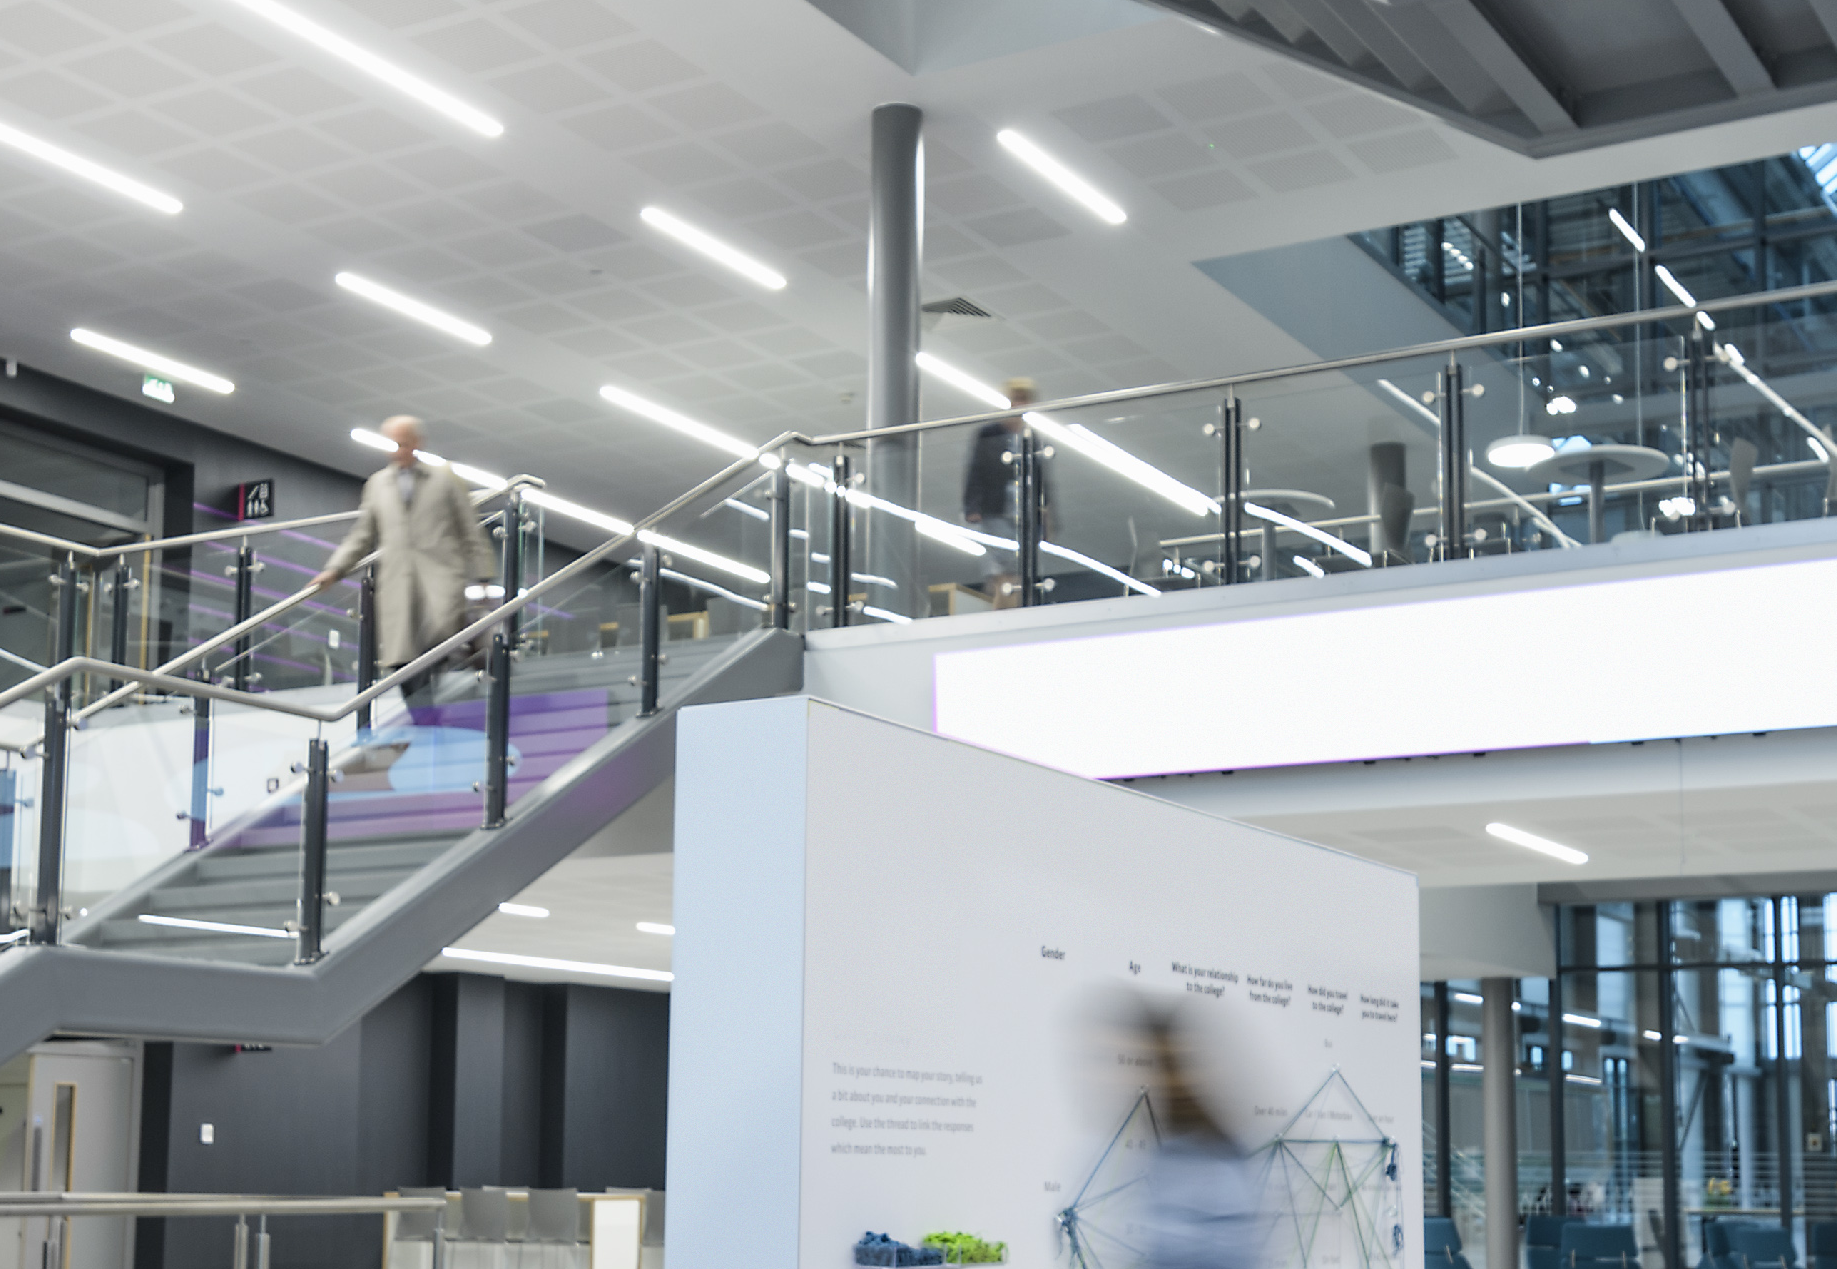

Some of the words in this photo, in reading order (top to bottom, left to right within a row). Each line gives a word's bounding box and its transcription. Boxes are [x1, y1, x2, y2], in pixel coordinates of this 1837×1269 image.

[1041, 945, 1066, 960] Gender
[1129, 960, 1141, 975] Age
[1171, 961, 1187, 974] What
[1188, 964, 1193, 975] is
[1194, 967, 1206, 978] your
[1207, 968, 1239, 984] relationship
[1186, 982, 1193, 992] to
[1194, 982, 1203, 993] the
[1204, 983, 1226, 999] college?
[1247, 973, 1258, 985] How
[1267, 977, 1274, 989] do
[1275, 981, 1284, 992] you
[1249, 989, 1262, 1002] from
[1262, 992, 1271, 1003] the
[1308, 983, 1318, 995] How
[1326, 989, 1335, 999] you
[1335, 988, 1348, 1000] travel
[1312, 1001, 1318, 1011] to
[1318, 1001, 1326, 1012] the
[833, 1062, 847, 1075] This
[849, 1063, 855, 1075] is
[856, 1067, 871, 1079] your
[873, 1065, 896, 1078] chance
[897, 1067, 905, 1079] to
[906, 1069, 920, 1081] map
[921, 1072, 935, 1082] your
[956, 1071, 975, 1086] telling
[976, 1075, 983, 1084] us
[838, 1089, 848, 1101] bit
[850, 1090, 870, 1102] about
[871, 1093, 884, 1106] you
[885, 1092, 898, 1104] and
[899, 1095, 914, 1107] your
[915, 1095, 949, 1106] connection
[951, 1095, 965, 1107] with
[966, 1096, 977, 1108] the
[859, 1117, 873, 1128] Use
[873, 1116, 885, 1129] the
[886, 1118, 909, 1130] thread
[910, 1119, 917, 1130] to
[918, 1118, 930, 1130] link
[931, 1118, 943, 1131] the
[944, 1123, 974, 1133] responses
[831, 1141, 852, 1155] which
[853, 1144, 873, 1155] mean
[873, 1142, 886, 1155] the
[887, 1144, 904, 1155] most
[905, 1144, 913, 1155] to
[1044, 1180, 1061, 1193] Male
